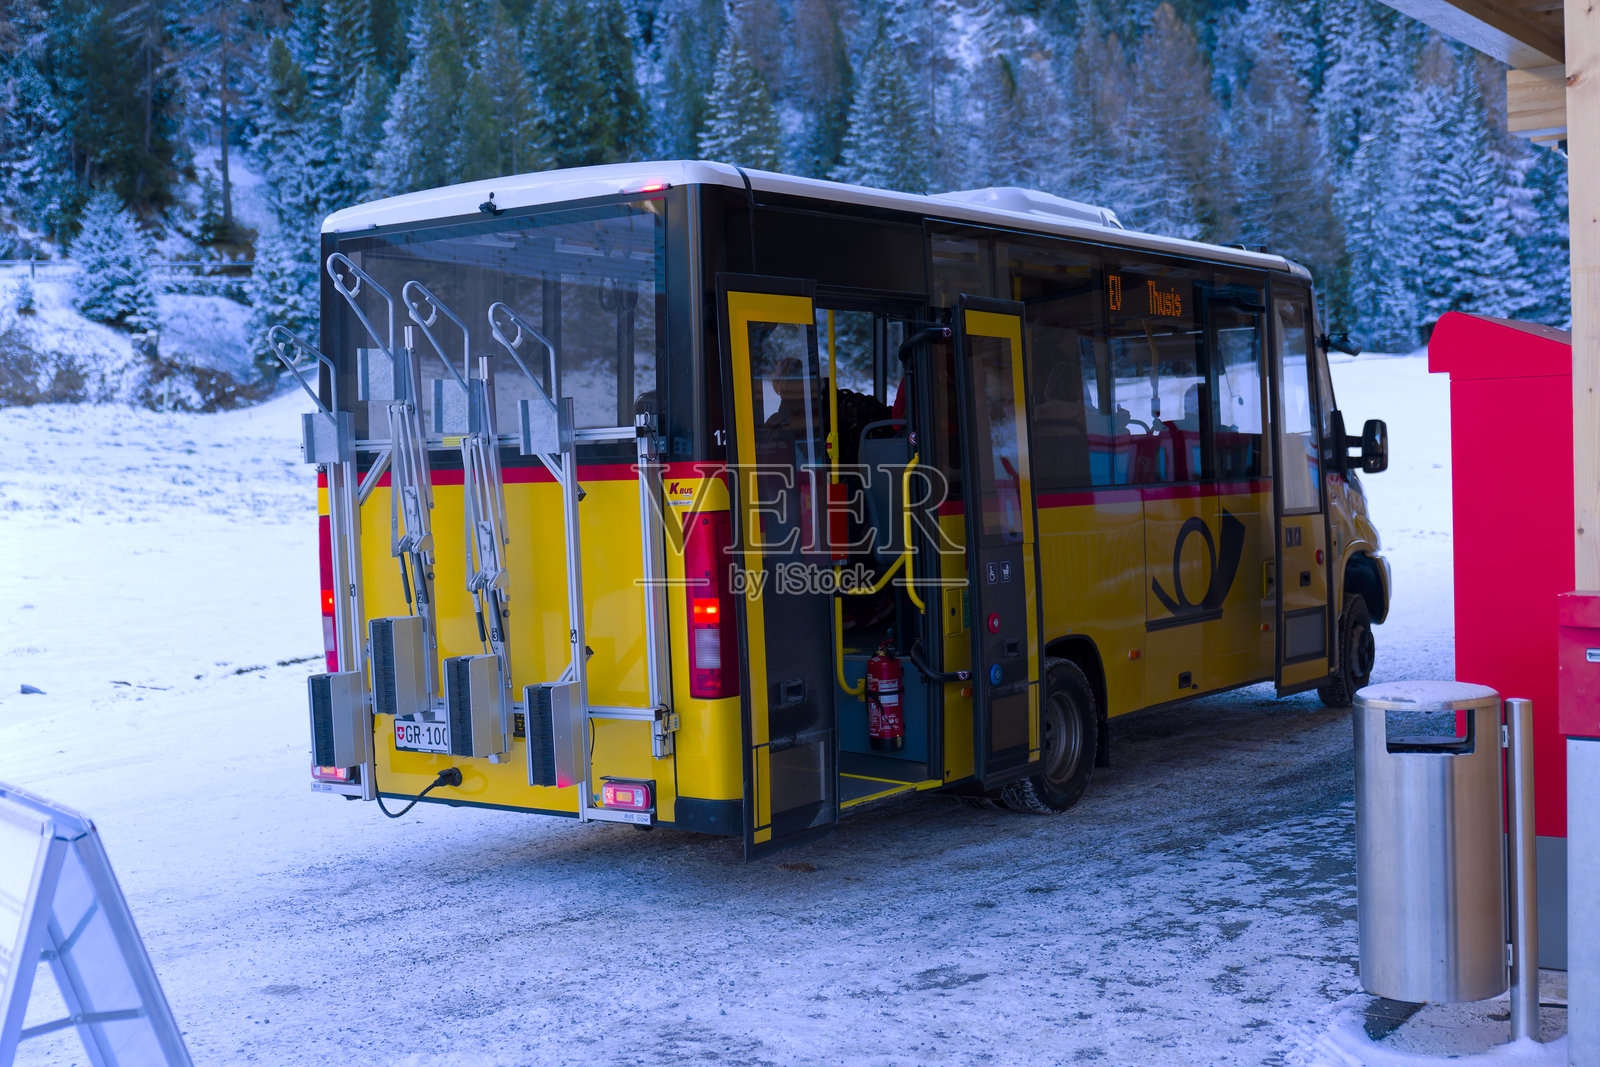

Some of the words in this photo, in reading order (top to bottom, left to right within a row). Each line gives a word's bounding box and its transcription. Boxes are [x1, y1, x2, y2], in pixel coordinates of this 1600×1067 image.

[1147, 280, 1182, 317] Thusis
[669, 482, 680, 495] K
[679, 487, 693, 495] BUS
